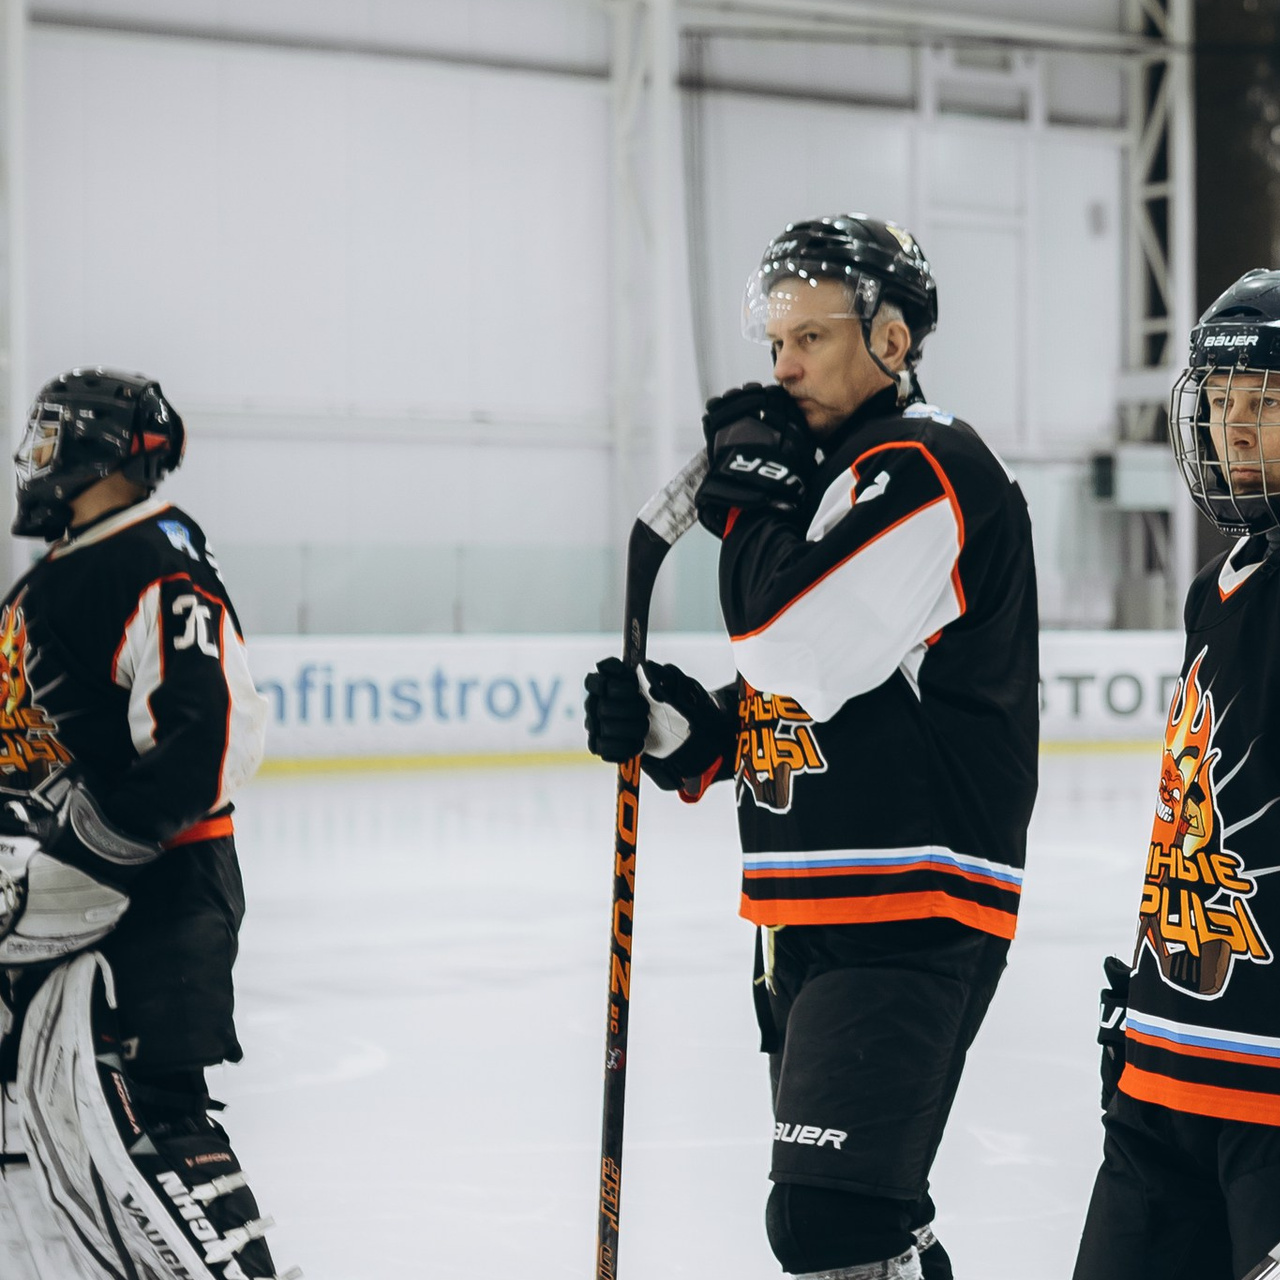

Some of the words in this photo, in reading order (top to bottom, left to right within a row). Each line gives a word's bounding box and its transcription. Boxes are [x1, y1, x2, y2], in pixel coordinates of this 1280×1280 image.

[1204, 335, 1259, 347] BAUER
[729, 454, 805, 494] UER
[735, 726, 822, 780] РЦЫ
[1140, 885, 1266, 958] РЦЫ
[772, 1121, 848, 1150] AUER
